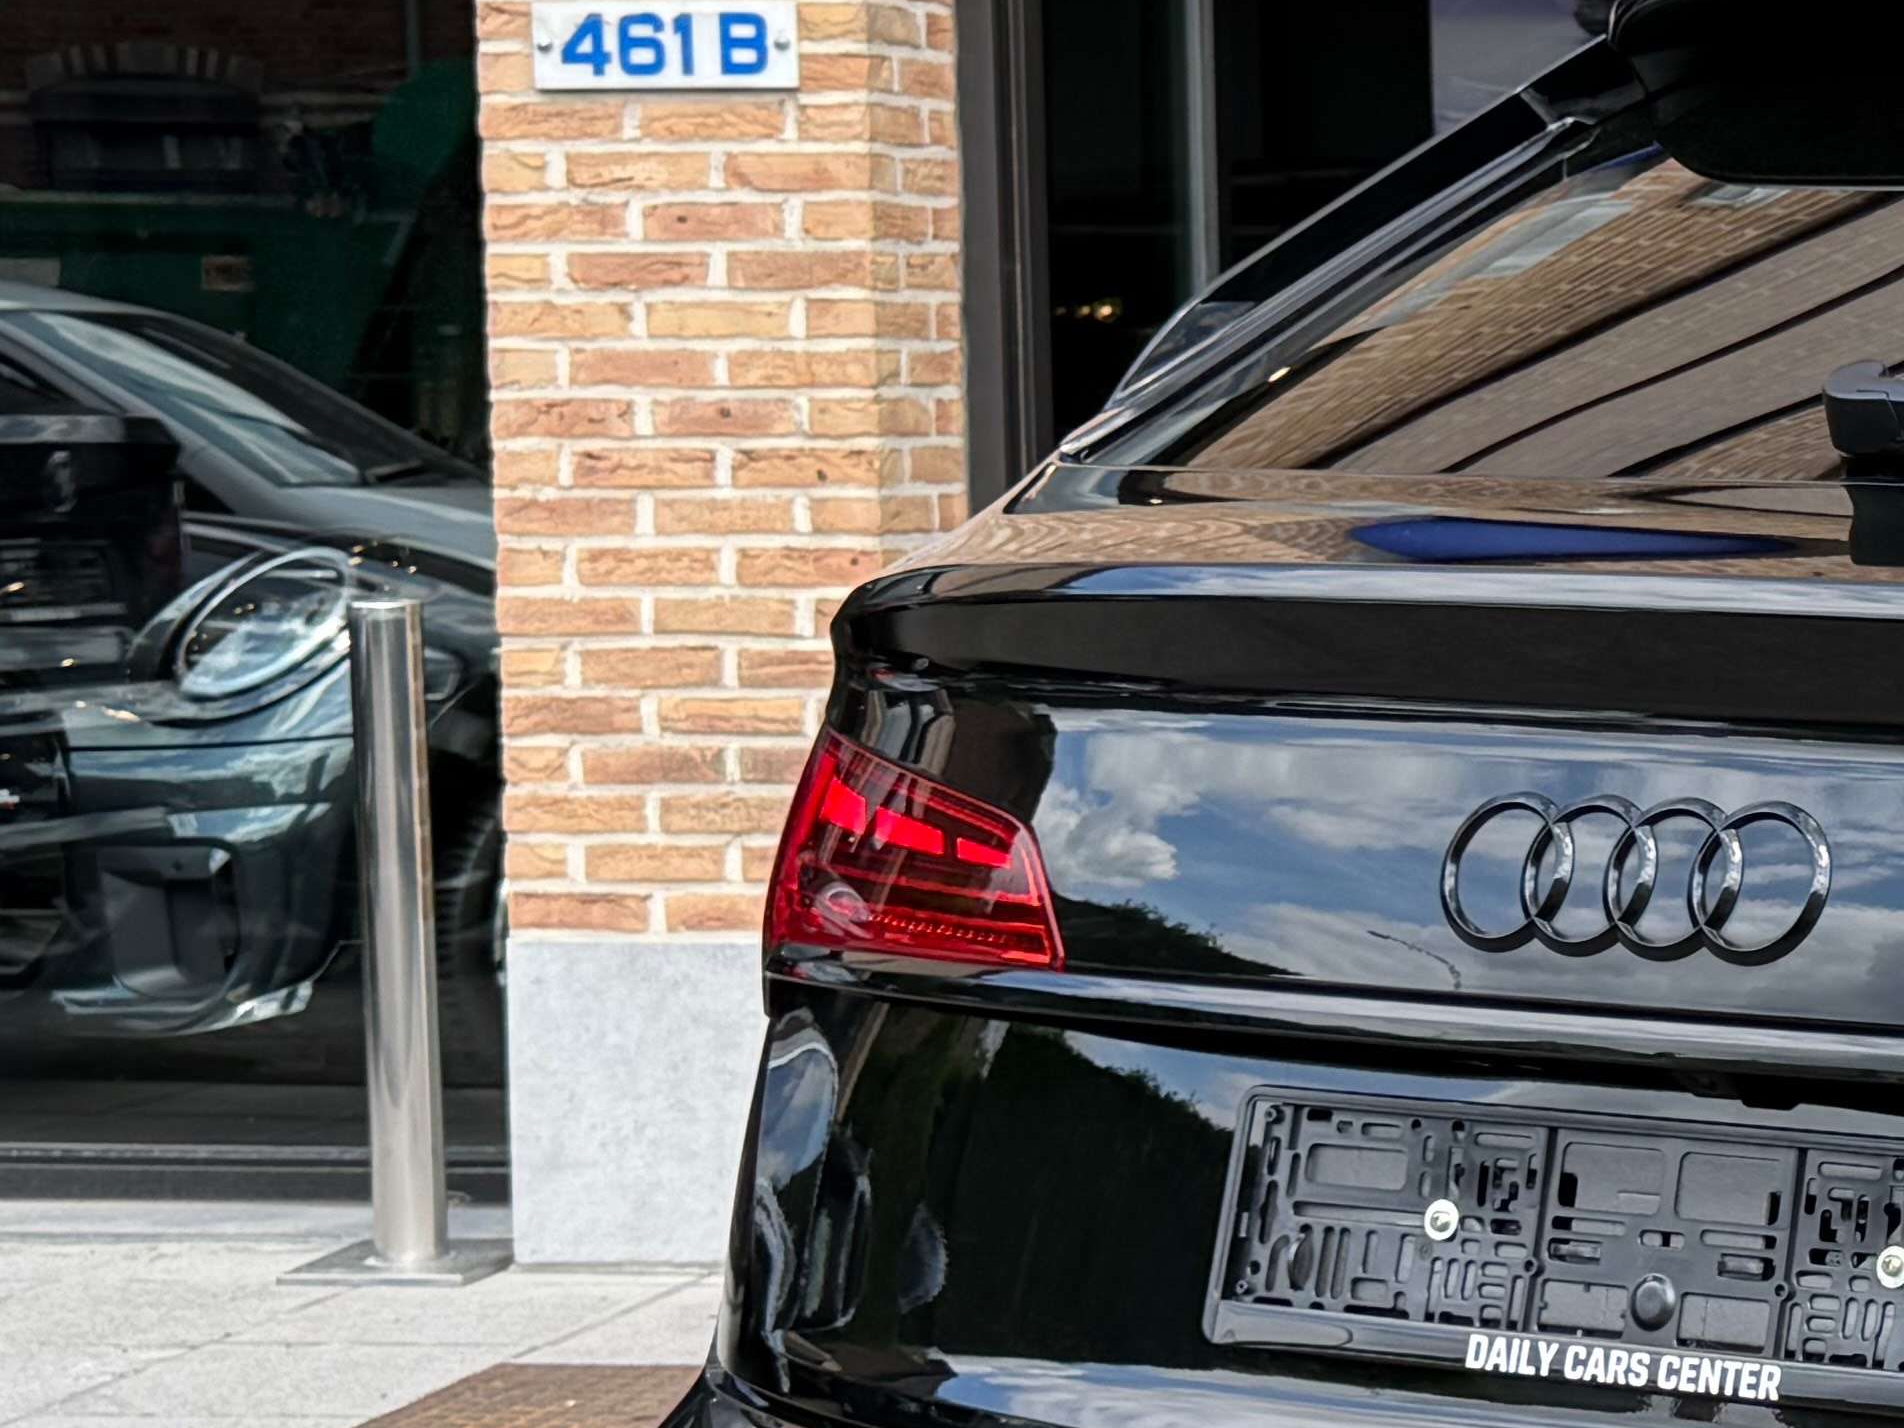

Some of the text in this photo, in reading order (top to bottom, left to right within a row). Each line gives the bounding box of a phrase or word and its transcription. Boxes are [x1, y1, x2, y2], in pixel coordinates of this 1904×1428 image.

[1464, 1333, 1782, 1401] DAILY CARS CENTER
